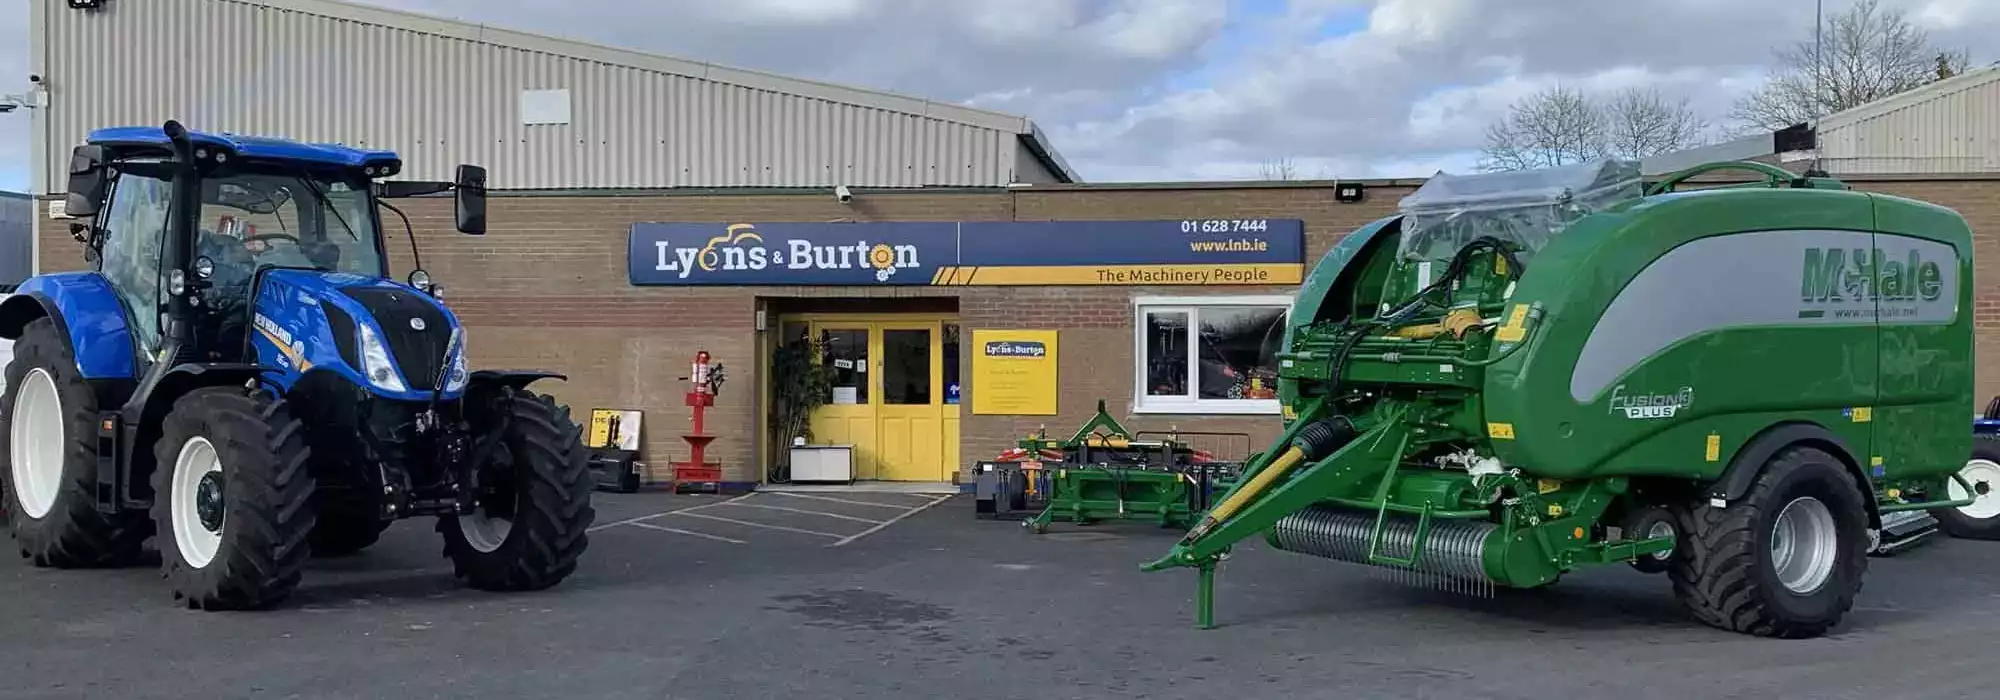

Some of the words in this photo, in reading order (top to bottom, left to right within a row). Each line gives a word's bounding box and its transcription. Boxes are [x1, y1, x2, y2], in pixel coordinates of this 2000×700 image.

[1180, 220, 1197, 233] 01
[1202, 220, 1229, 233] 628
[1232, 219, 1268, 232] 7444
[1190, 238, 1268, 252] www.lnb.ie
[655, 239, 768, 279] Lyons
[772, 250, 784, 265] &
[787, 239, 920, 270] Burton
[1096, 269, 1125, 282] The
[1129, 267, 1209, 284] Machinery
[1214, 267, 1268, 283] People
[1800, 247, 1941, 302] McHale
[1631, 407, 1672, 417] PLUS
